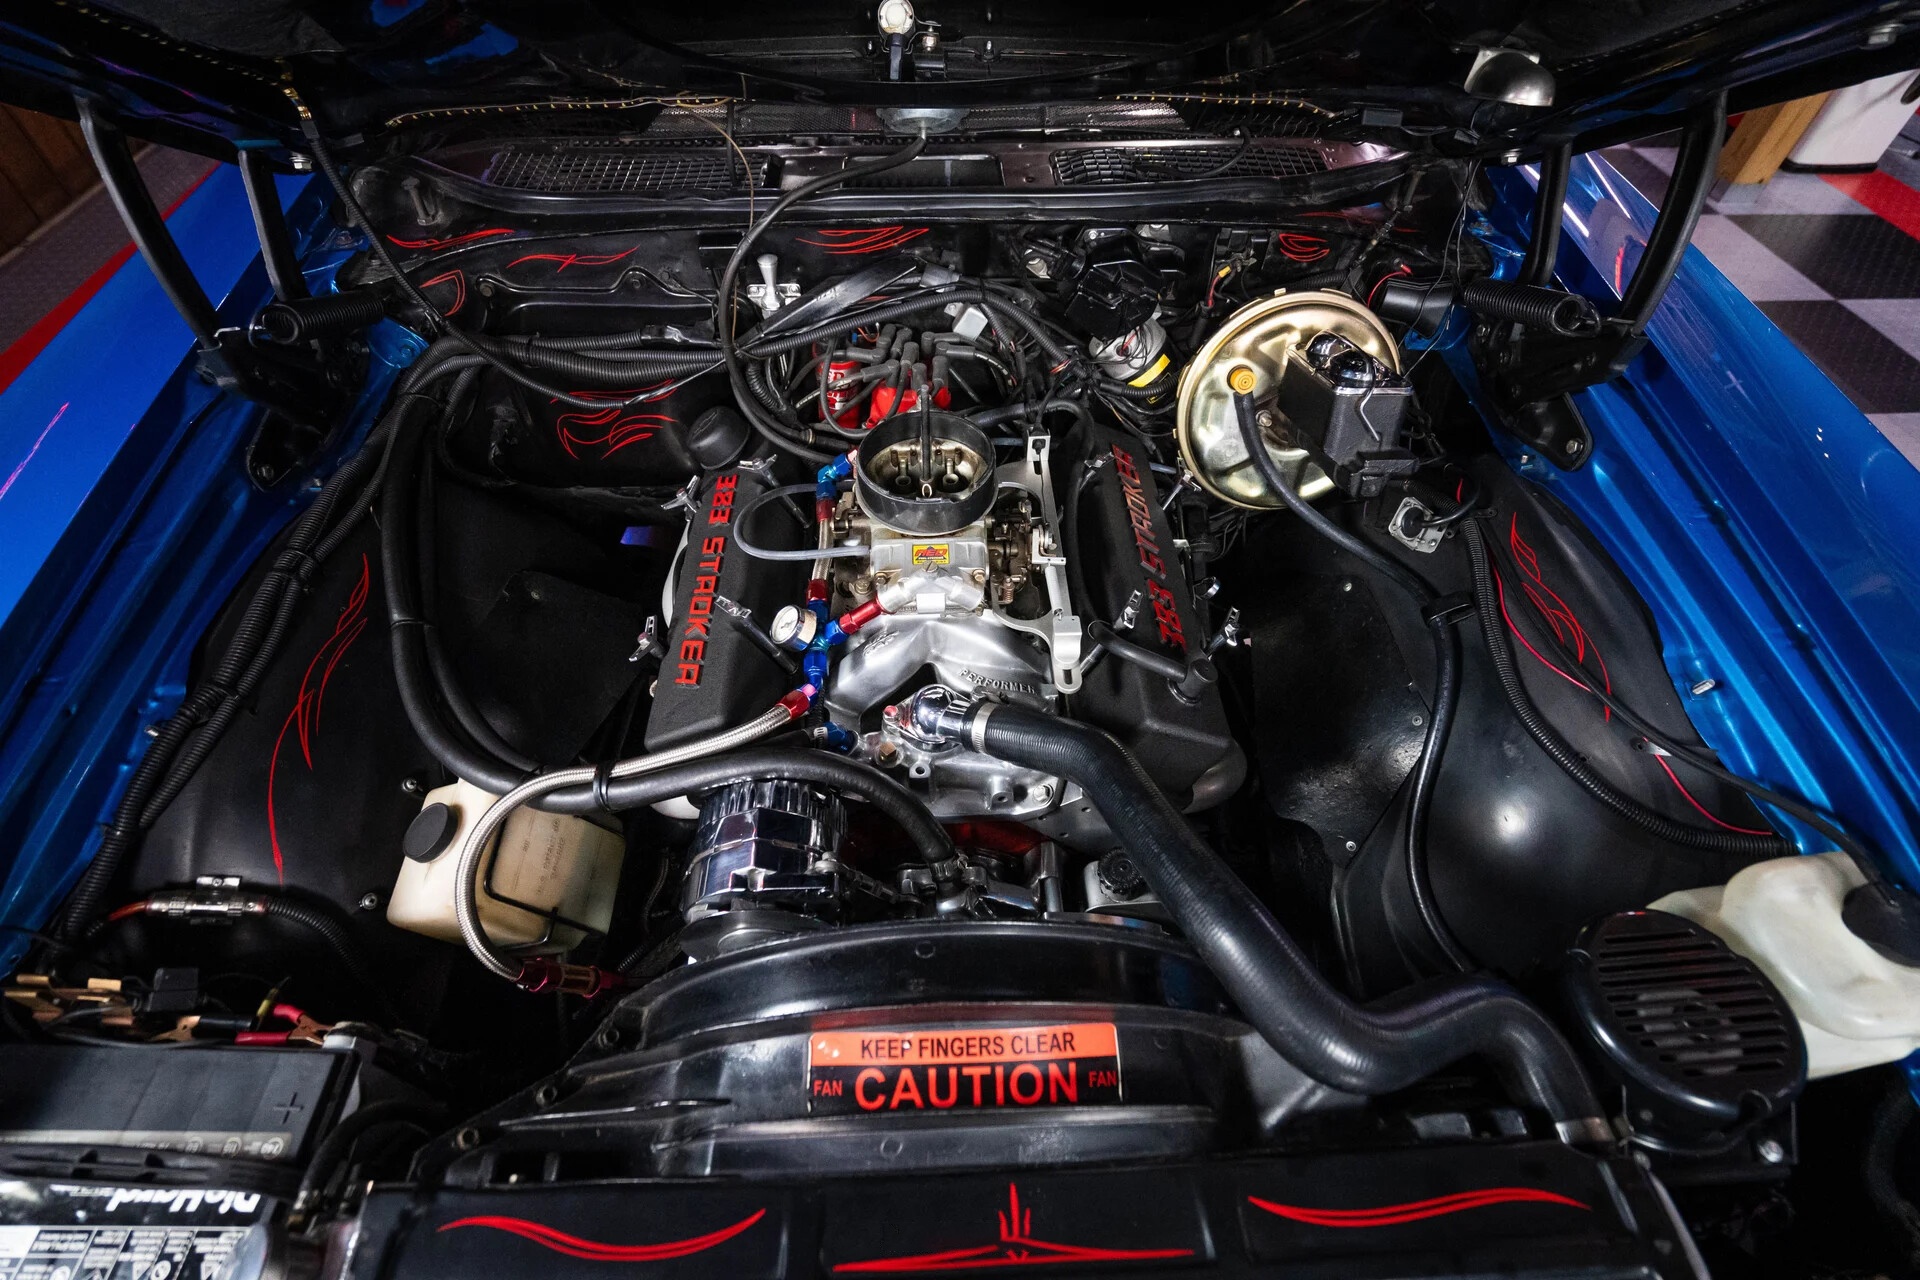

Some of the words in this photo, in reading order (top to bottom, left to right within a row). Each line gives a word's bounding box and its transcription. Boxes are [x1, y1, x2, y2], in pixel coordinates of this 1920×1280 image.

[708, 473, 738, 525] 383
[1112, 444, 1167, 580] STROKER
[674, 536, 726, 686] STROKER
[1146, 578, 1187, 654] 383
[958, 667, 1036, 694] PERFORMER
[860, 1039, 912, 1060] KEEP
[918, 1036, 1005, 1058] FINGERS
[1011, 1031, 1076, 1054] CLEAR
[813, 1079, 843, 1097] FAN
[854, 1061, 1078, 1111] CAUTION
[1088, 1070, 1117, 1088] FAN
